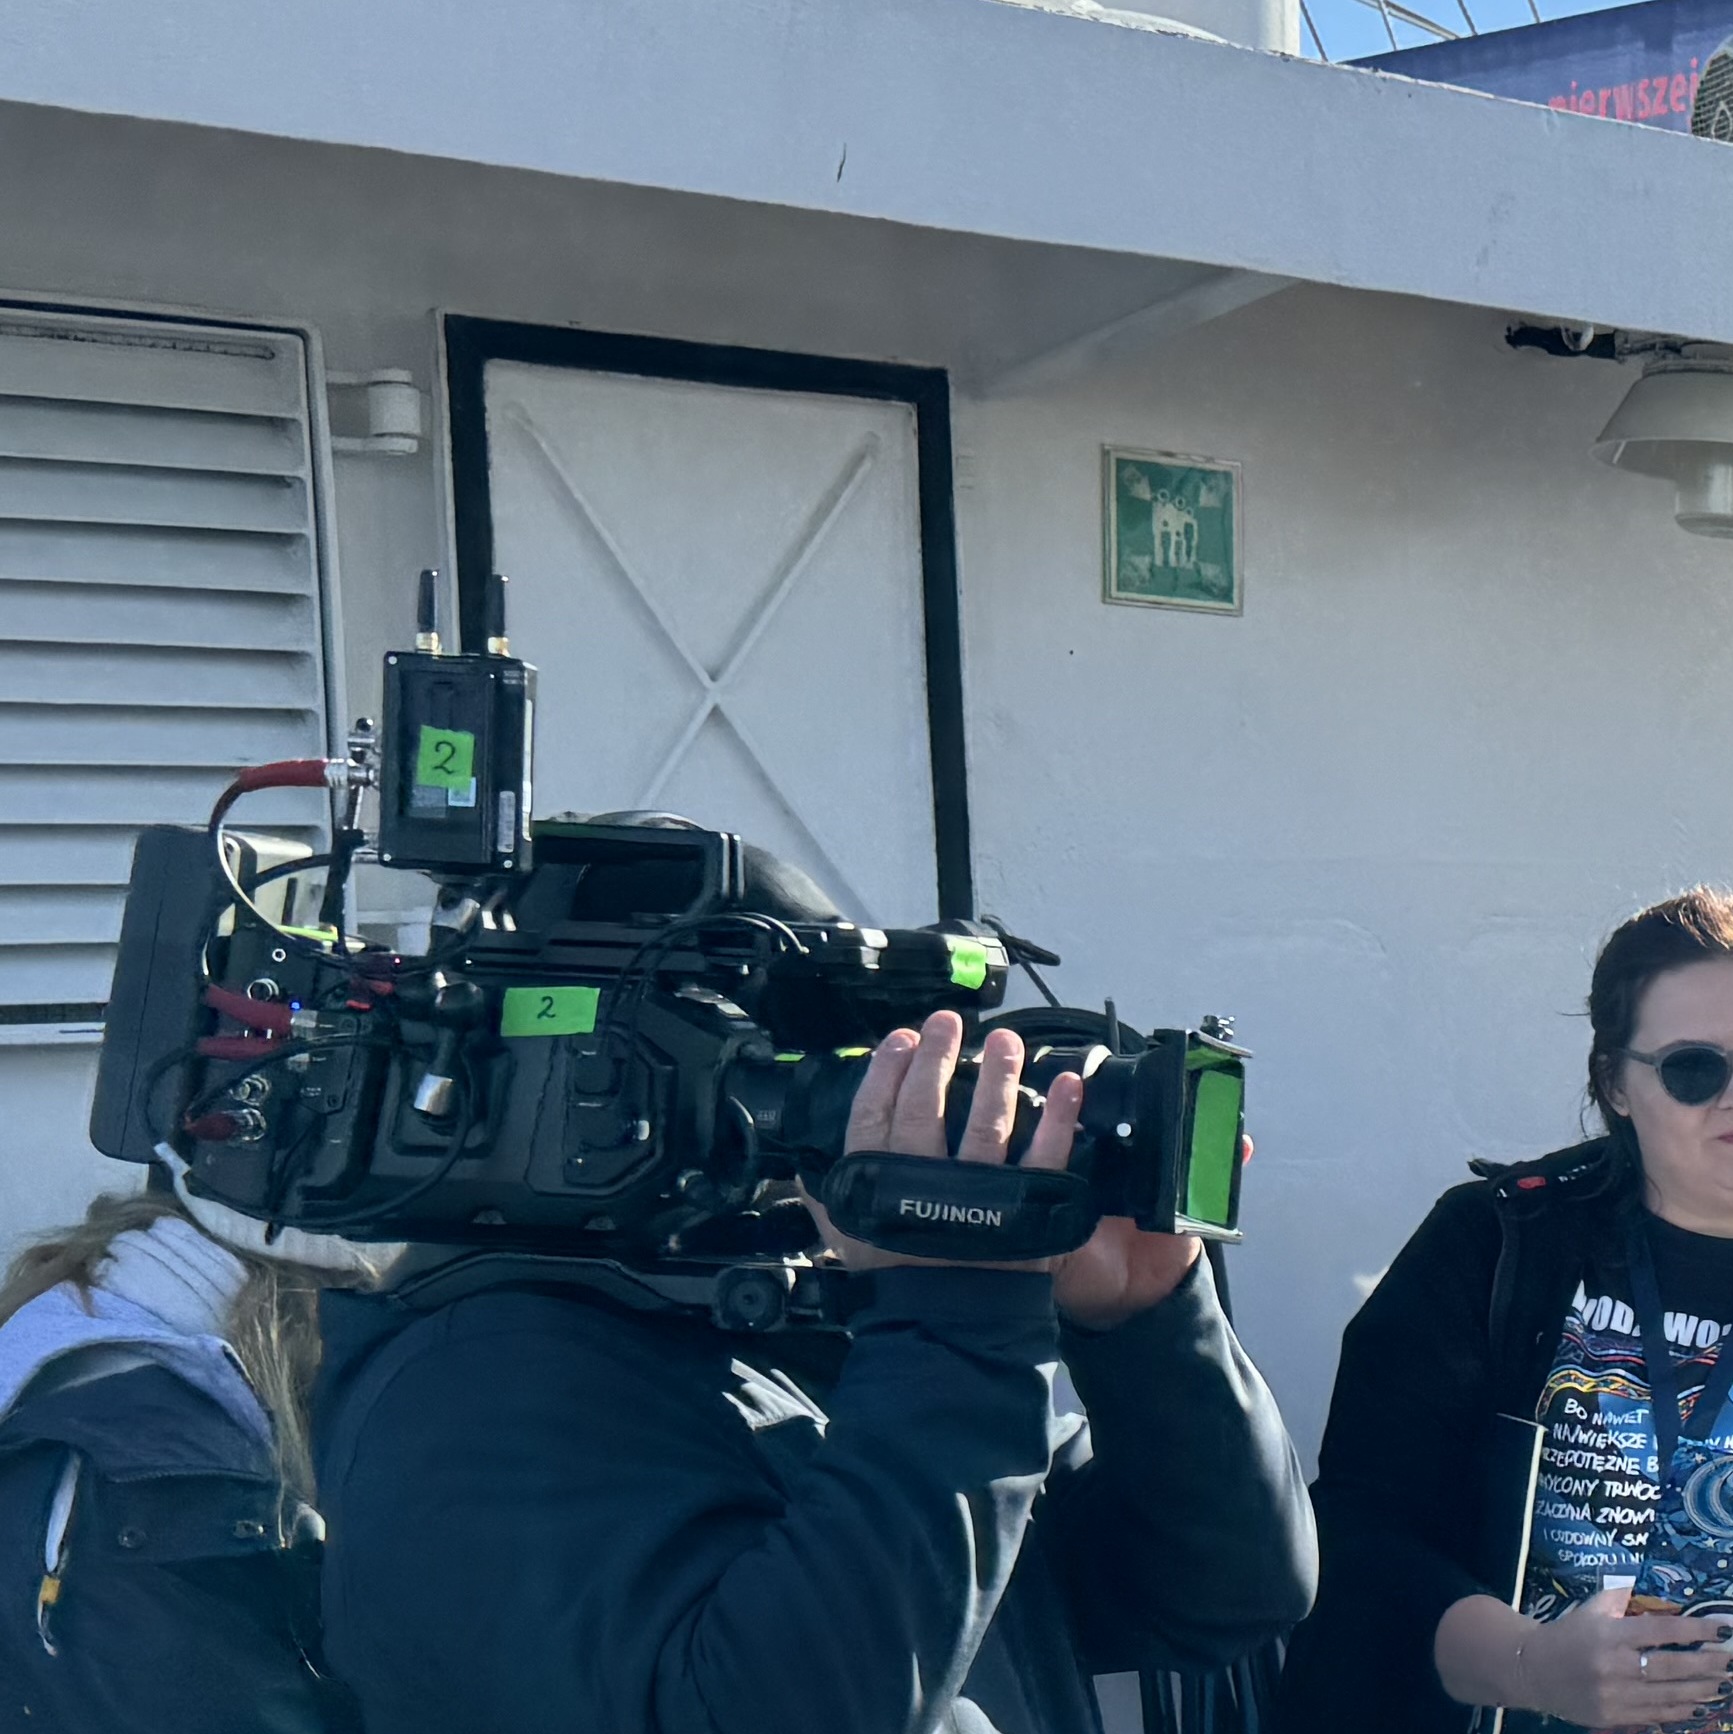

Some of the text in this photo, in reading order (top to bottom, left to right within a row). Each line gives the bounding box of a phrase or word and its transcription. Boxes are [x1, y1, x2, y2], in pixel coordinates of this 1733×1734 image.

[432, 740, 456, 775] 2
[537, 996, 556, 1019] 2
[900, 1199, 1002, 1227] FUJINON
[1592, 1408, 1650, 1425] NAWET
